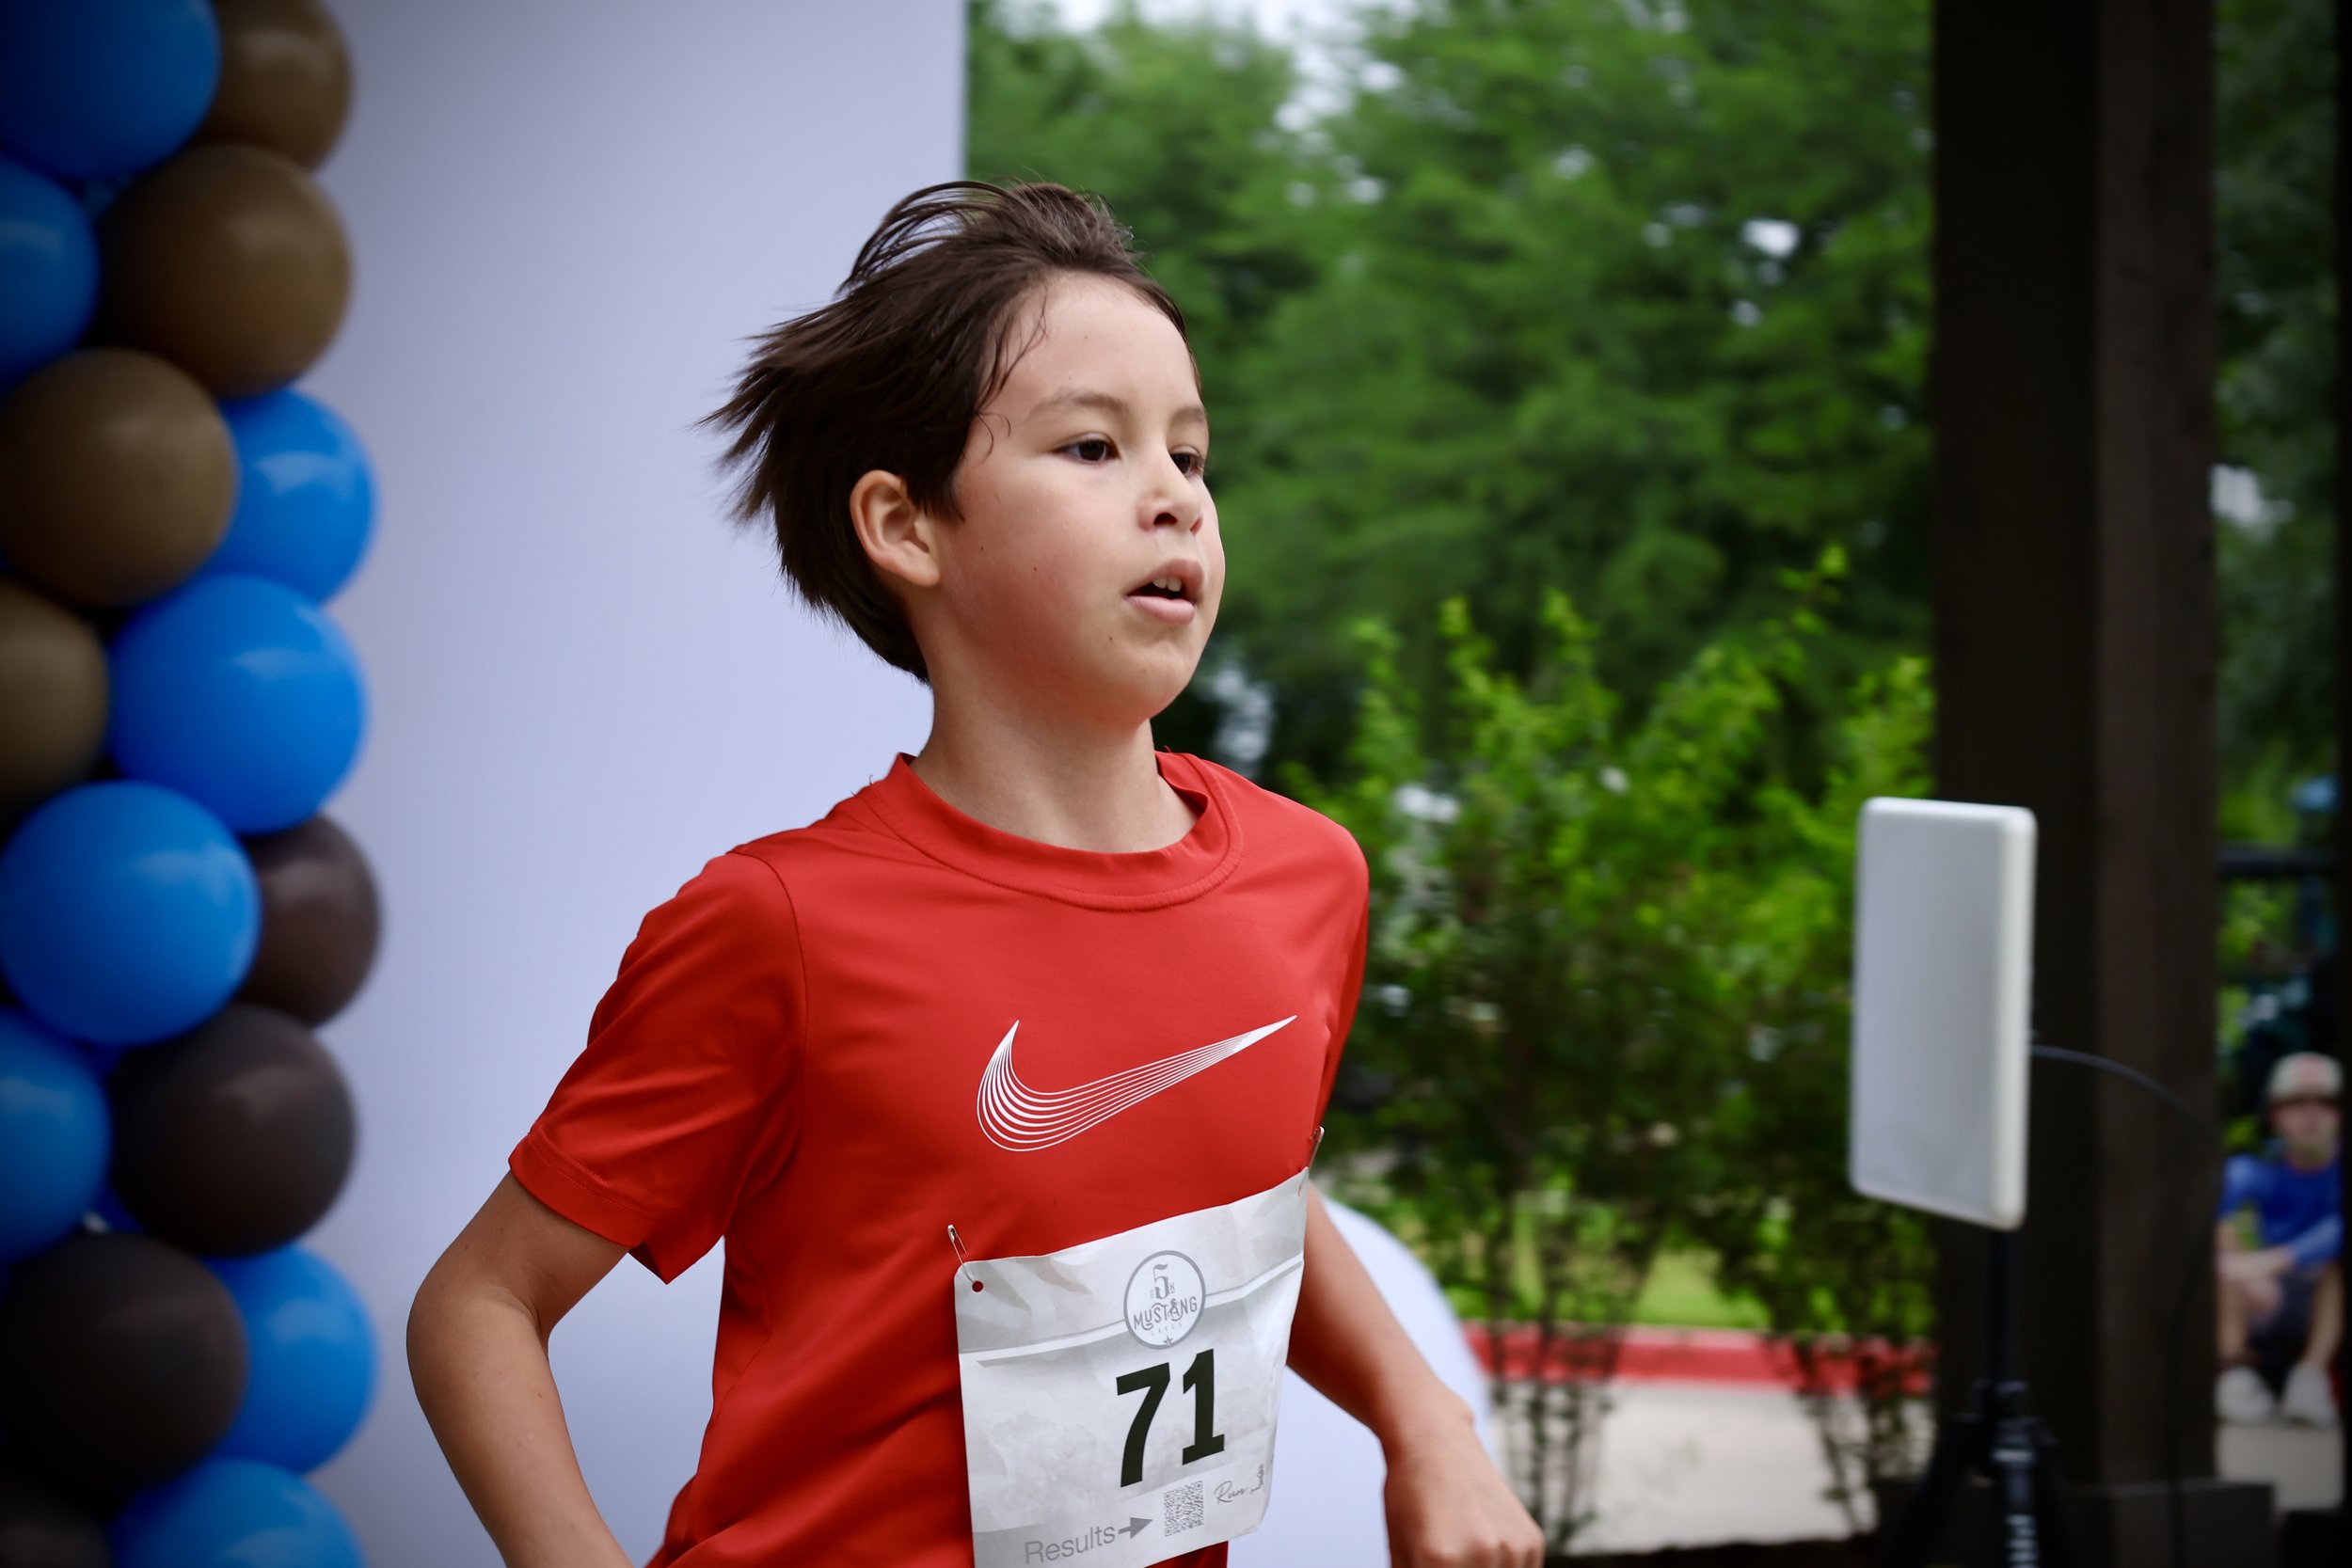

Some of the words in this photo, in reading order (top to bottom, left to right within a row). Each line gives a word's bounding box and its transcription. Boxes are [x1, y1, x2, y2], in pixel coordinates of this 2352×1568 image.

[1134, 1296, 1198, 1331] MUSTANG
[1116, 1348, 1225, 1487] 71
[1024, 1526, 1116, 1565] Results
